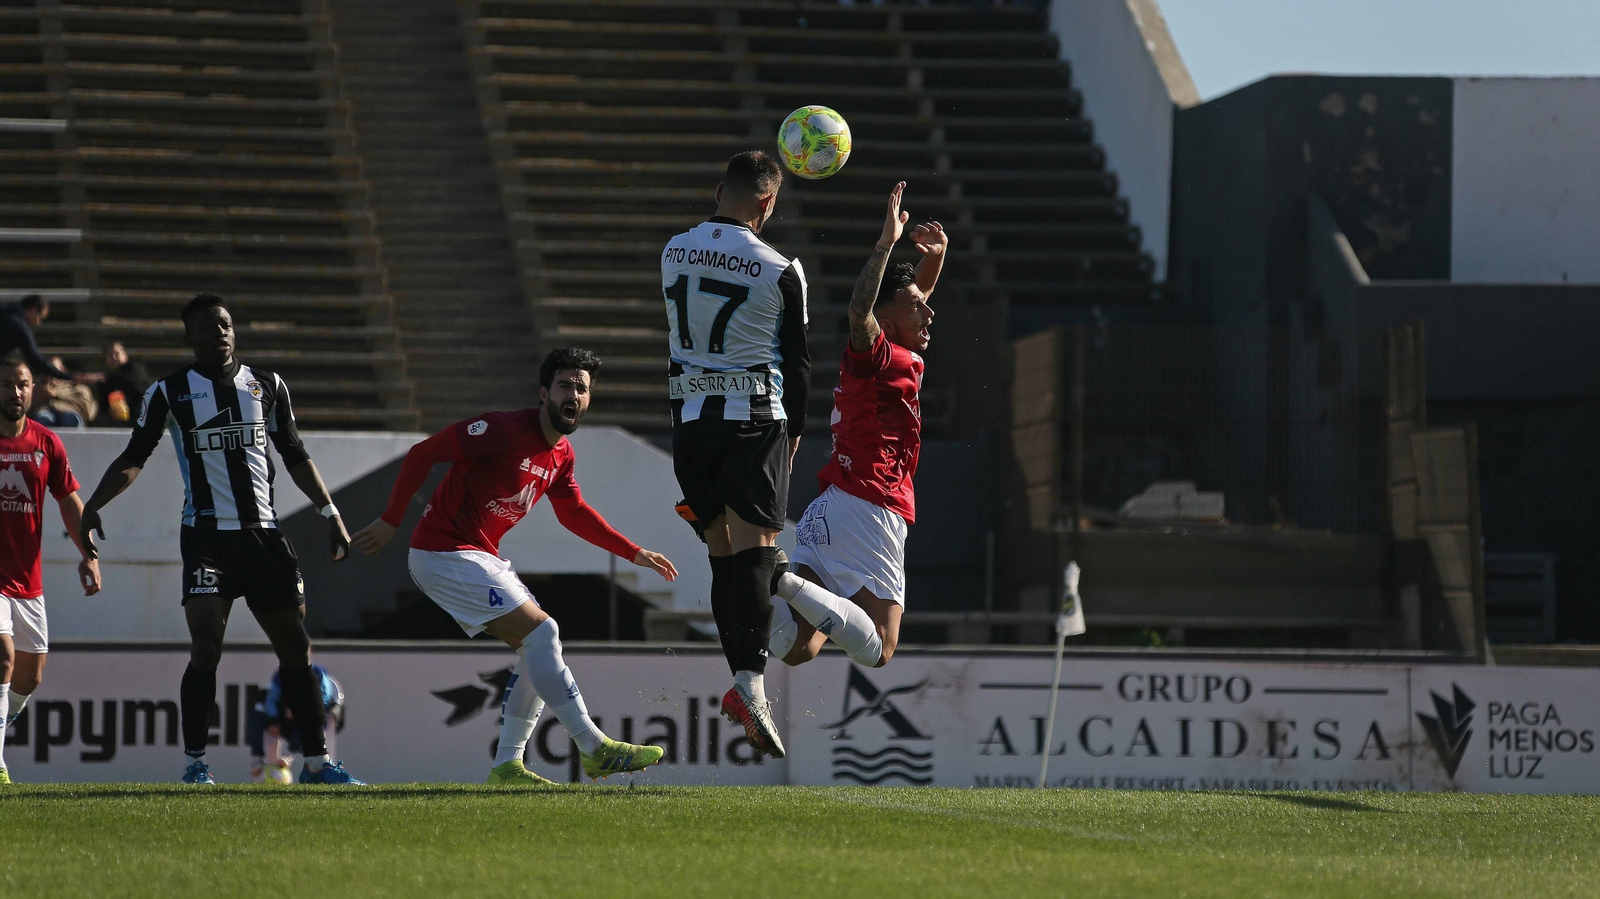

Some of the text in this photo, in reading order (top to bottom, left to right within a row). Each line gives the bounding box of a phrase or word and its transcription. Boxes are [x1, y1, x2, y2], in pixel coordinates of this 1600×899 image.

[665, 248, 761, 278] PITO CAMACHO
[665, 273, 750, 354] 17
[178, 392, 208, 402] LEGEA
[670, 375, 764, 396] LA SERRANA
[193, 424, 267, 453] LOTUS
[193, 568, 218, 586] 15
[189, 586, 219, 594] LEGEA
[488, 587, 504, 608] 4
[1118, 673, 1253, 703] GRUPO
[1488, 701, 1562, 727] PAGA
[978, 716, 1392, 761] ALCAIDESA
[1488, 728, 1595, 754] MENOS
[1488, 755, 1545, 780] LUZ
[974, 775, 1047, 789] MARIN
